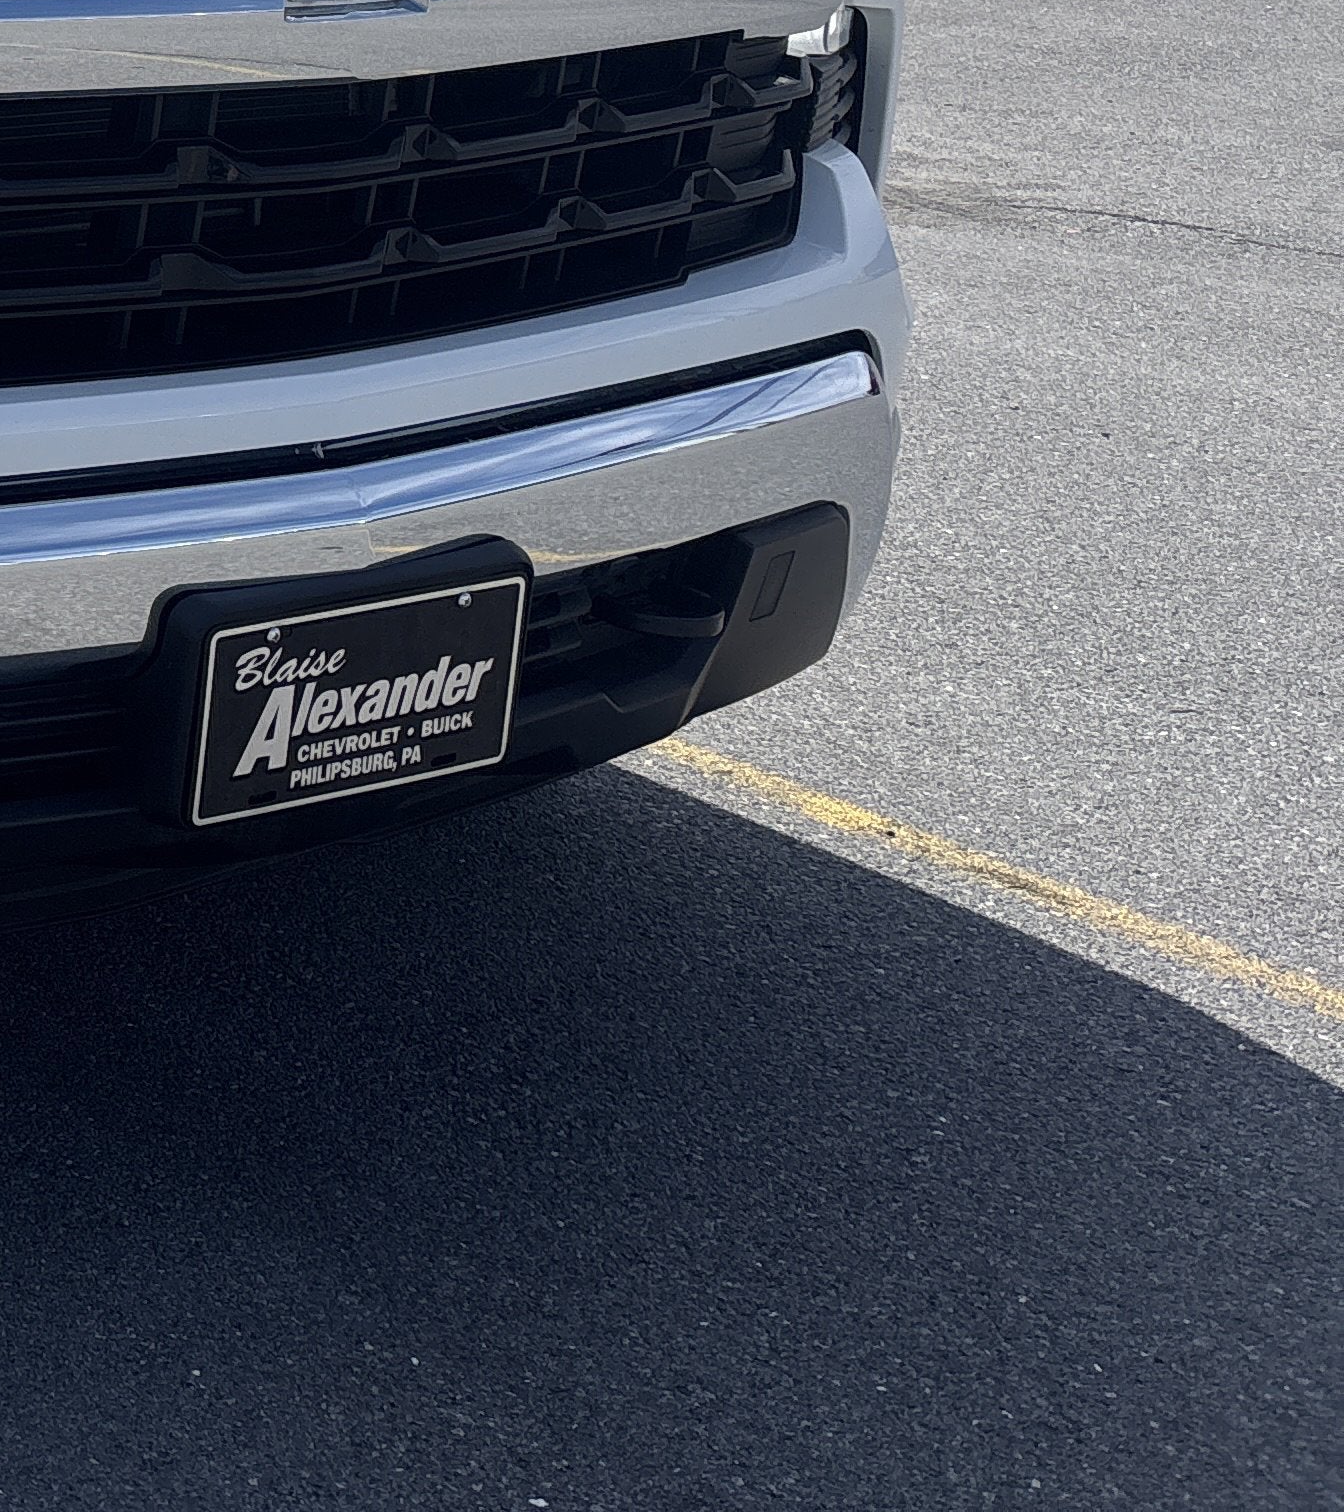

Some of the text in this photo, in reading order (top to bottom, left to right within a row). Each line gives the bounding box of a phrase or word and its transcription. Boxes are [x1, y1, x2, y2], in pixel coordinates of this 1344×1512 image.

[234, 646, 347, 691] Blaise
[232, 655, 495, 777] Alexander
[297, 710, 474, 763] CHEVROLET BUICK
[289, 745, 422, 789] PHILIPSBURG, PA
